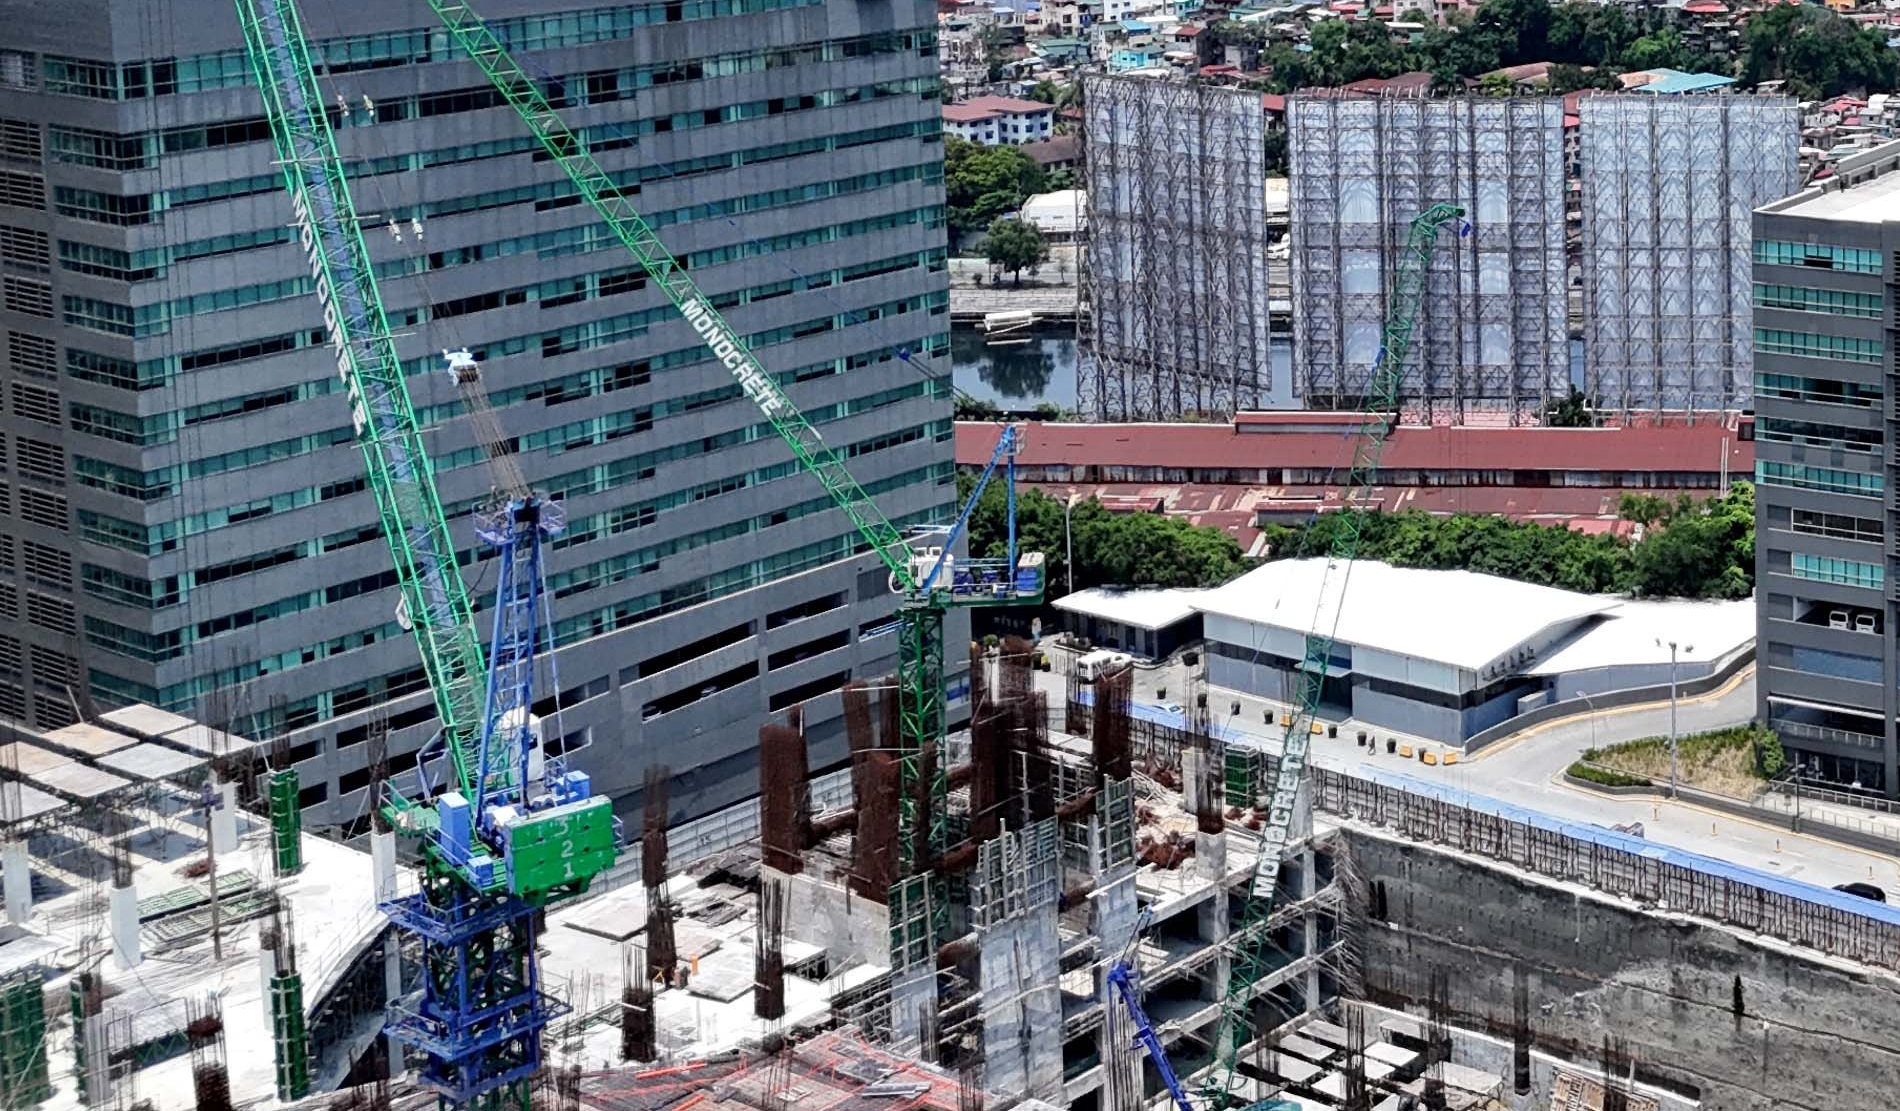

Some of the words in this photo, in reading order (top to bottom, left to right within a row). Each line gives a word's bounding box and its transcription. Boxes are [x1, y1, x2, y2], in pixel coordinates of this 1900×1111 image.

[679, 296, 783, 417] MONOCRETE
[561, 840, 574, 858] 2
[1253, 733, 1308, 898] MONOCRETE
[563, 862, 575, 878] 1
